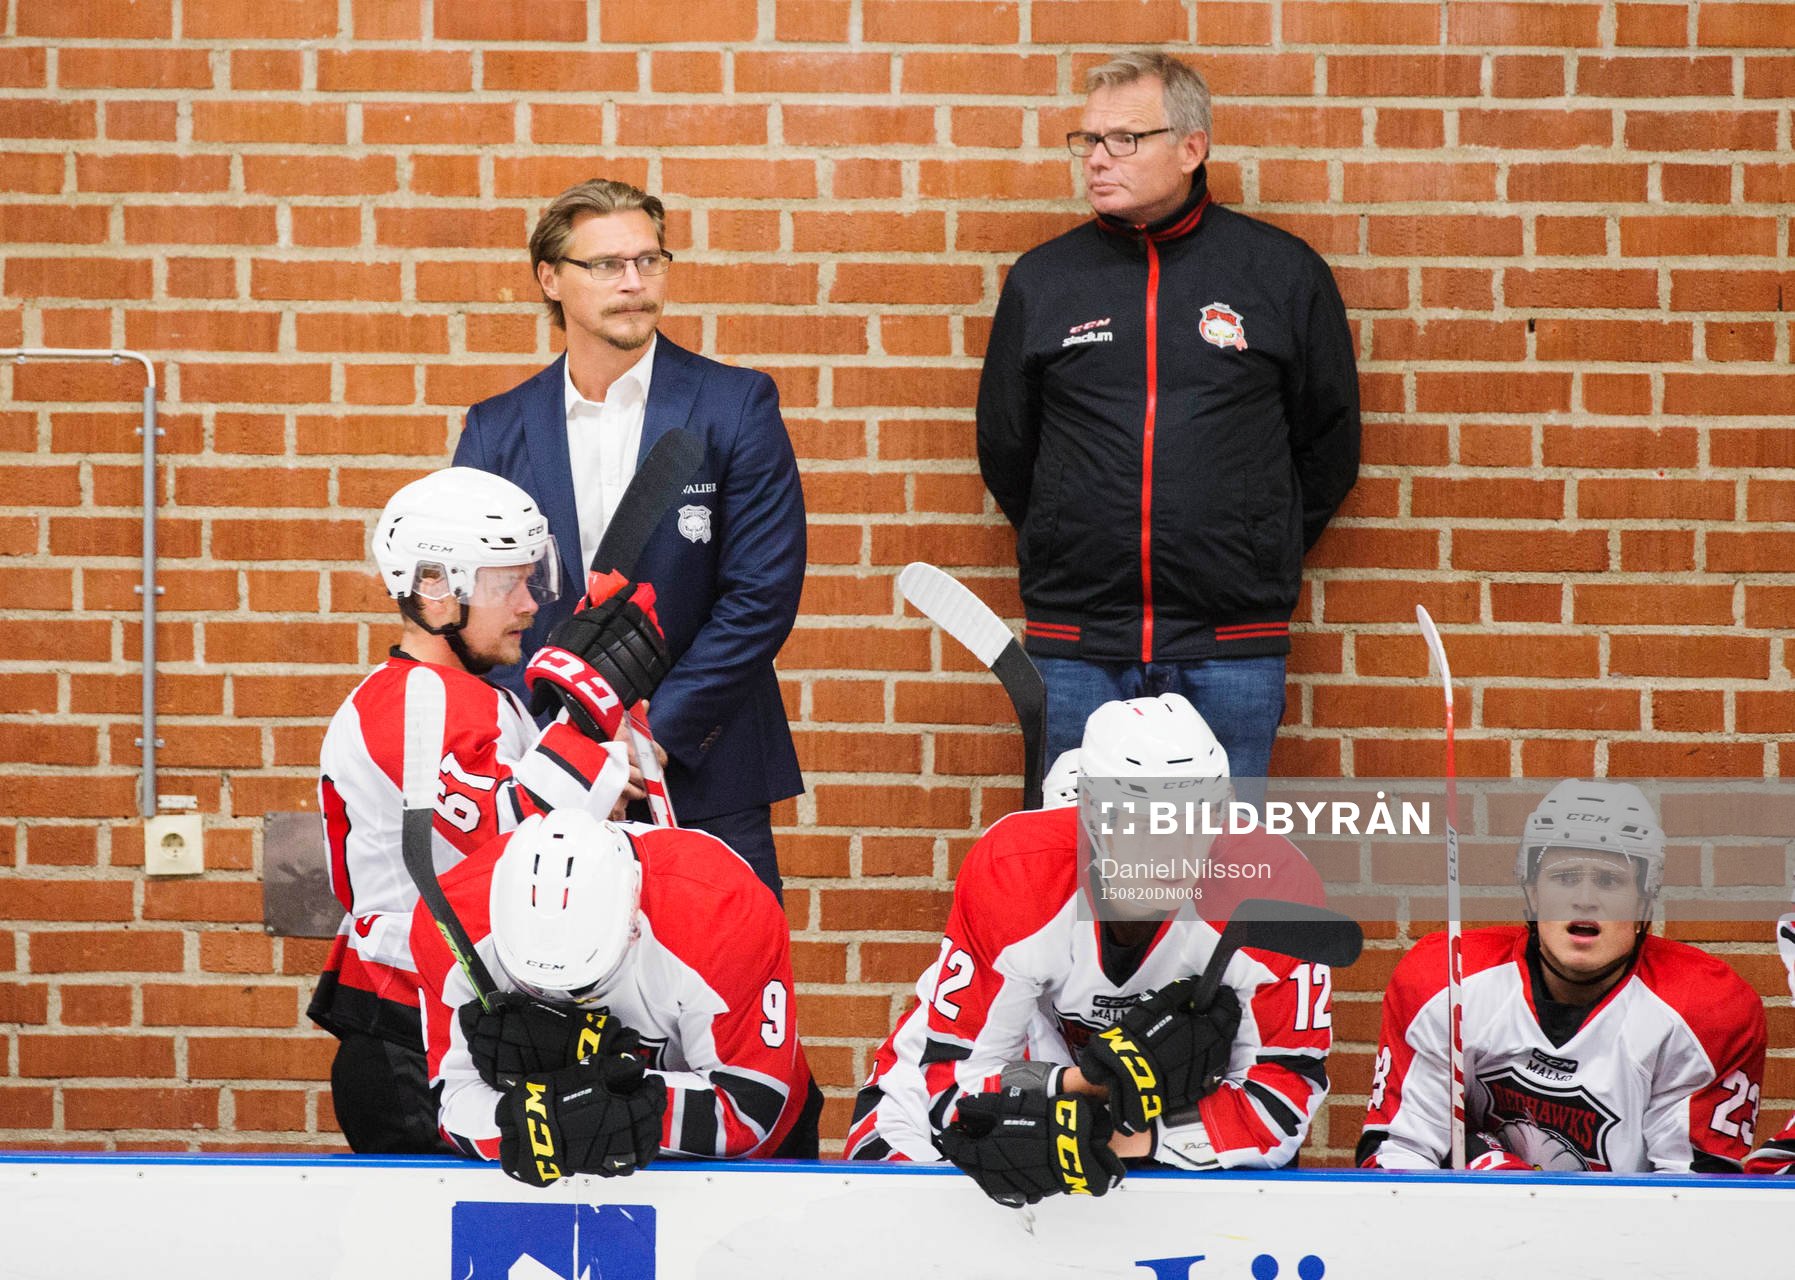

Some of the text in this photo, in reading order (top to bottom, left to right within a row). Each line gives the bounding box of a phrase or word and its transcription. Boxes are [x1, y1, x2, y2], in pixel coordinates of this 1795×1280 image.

[1062, 331, 1113, 347] stadium
[417, 542, 454, 553] CCM
[1565, 813, 1611, 824] CCM
[526, 959, 566, 971] CCM
[1288, 962, 1332, 1032] 12
[760, 979, 788, 1049] 9
[1098, 1026, 1163, 1123] CCM
[1709, 1069, 1761, 1147] 23
[525, 1081, 562, 1183] CCM
[1055, 1099, 1093, 1196] CCM
